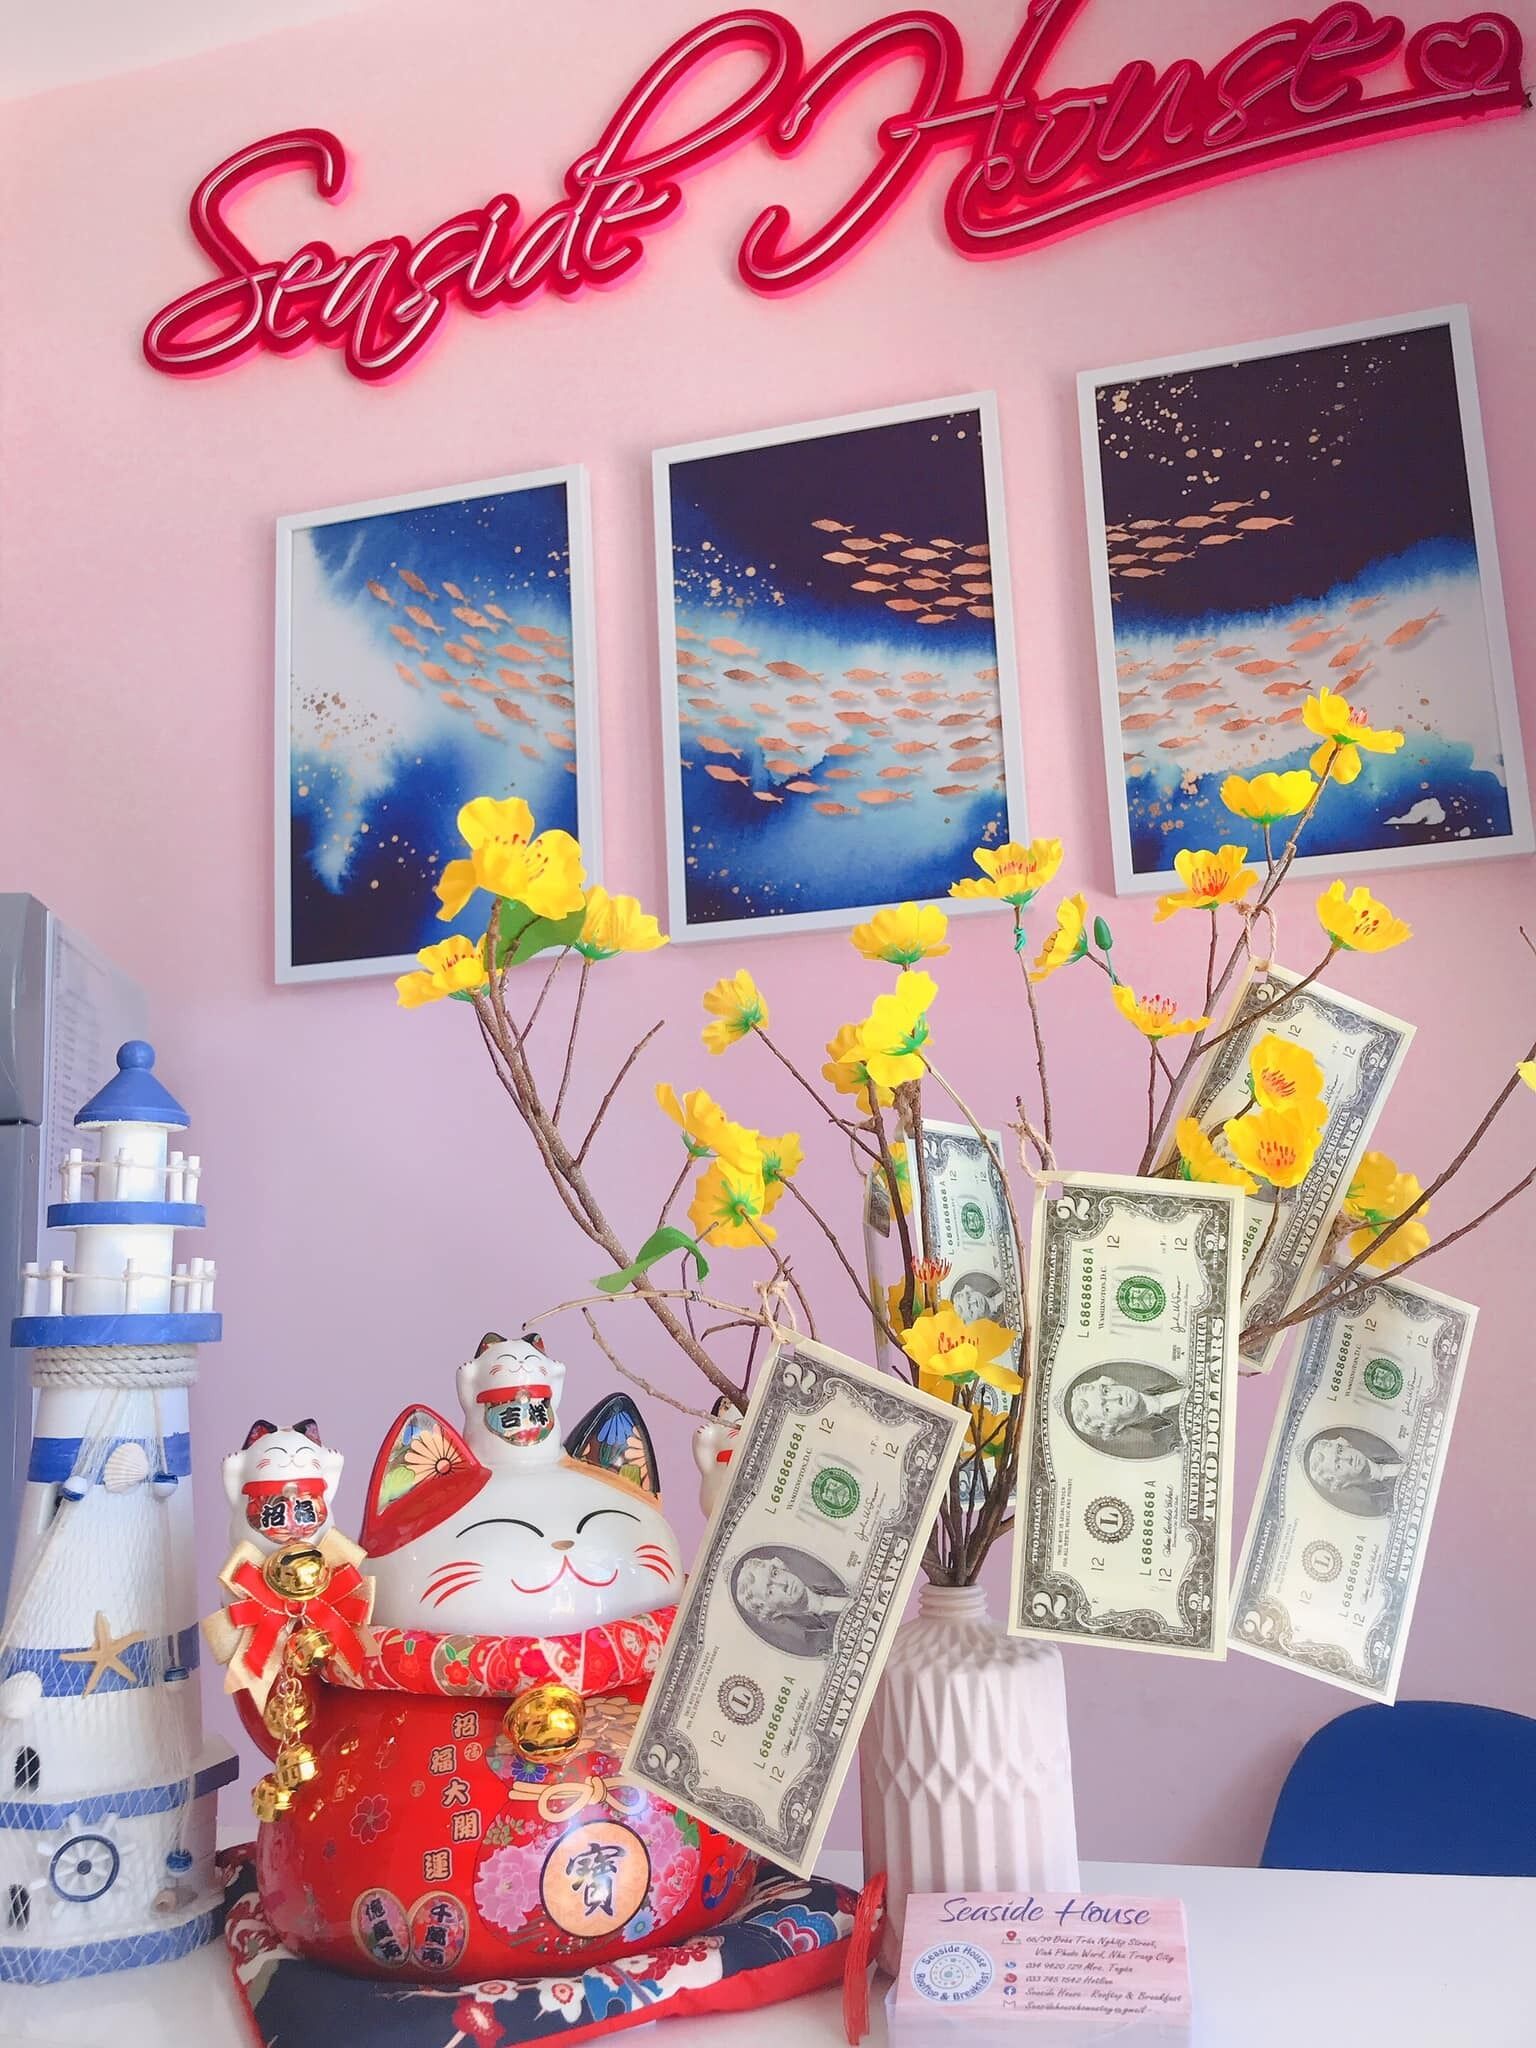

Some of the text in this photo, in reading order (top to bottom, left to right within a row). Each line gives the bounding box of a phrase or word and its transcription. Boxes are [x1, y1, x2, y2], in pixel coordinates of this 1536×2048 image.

[143, 0, 1405, 382] Seaside House
[1287, 1022, 1303, 1037] 12
[1341, 1044, 1356, 1059] 12
[1055, 1194, 1091, 1221] 2
[1106, 1232, 1120, 1249] 12
[1173, 1236, 1187, 1251] 12
[1204, 1232, 1226, 1250] 2
[1363, 1316, 1377, 1332] 12
[1416, 1333, 1429, 1349] 12
[778, 1359, 818, 1397] 2
[818, 1414, 836, 1435] 12
[1187, 1315, 1208, 1519] UNITED STATES OF AMERICA
[1202, 1316, 1225, 1522] TWO DOLLARS
[882, 1440, 900, 1460] 12
[261, 1500, 316, 1528] 招福
[1099, 1510, 1118, 1525] L
[861, 1529, 895, 1602] AMERICA
[1089, 1555, 1105, 1571] 12
[1157, 1566, 1172, 1583] 12
[1031, 1590, 1068, 1620] 2
[1188, 1591, 1210, 1611] 2
[827, 1673, 861, 1741] TWO
[851, 1535, 912, 1676] DOLLARS
[731, 1687, 751, 1708] L
[709, 1728, 727, 1748] 12
[645, 1739, 683, 1780] 2
[767, 1763, 785, 1784] 12
[940, 1896, 1150, 1928] Seaside House
[921, 1945, 987, 1968] Seaside House
[940, 1992, 949, 2001] &
